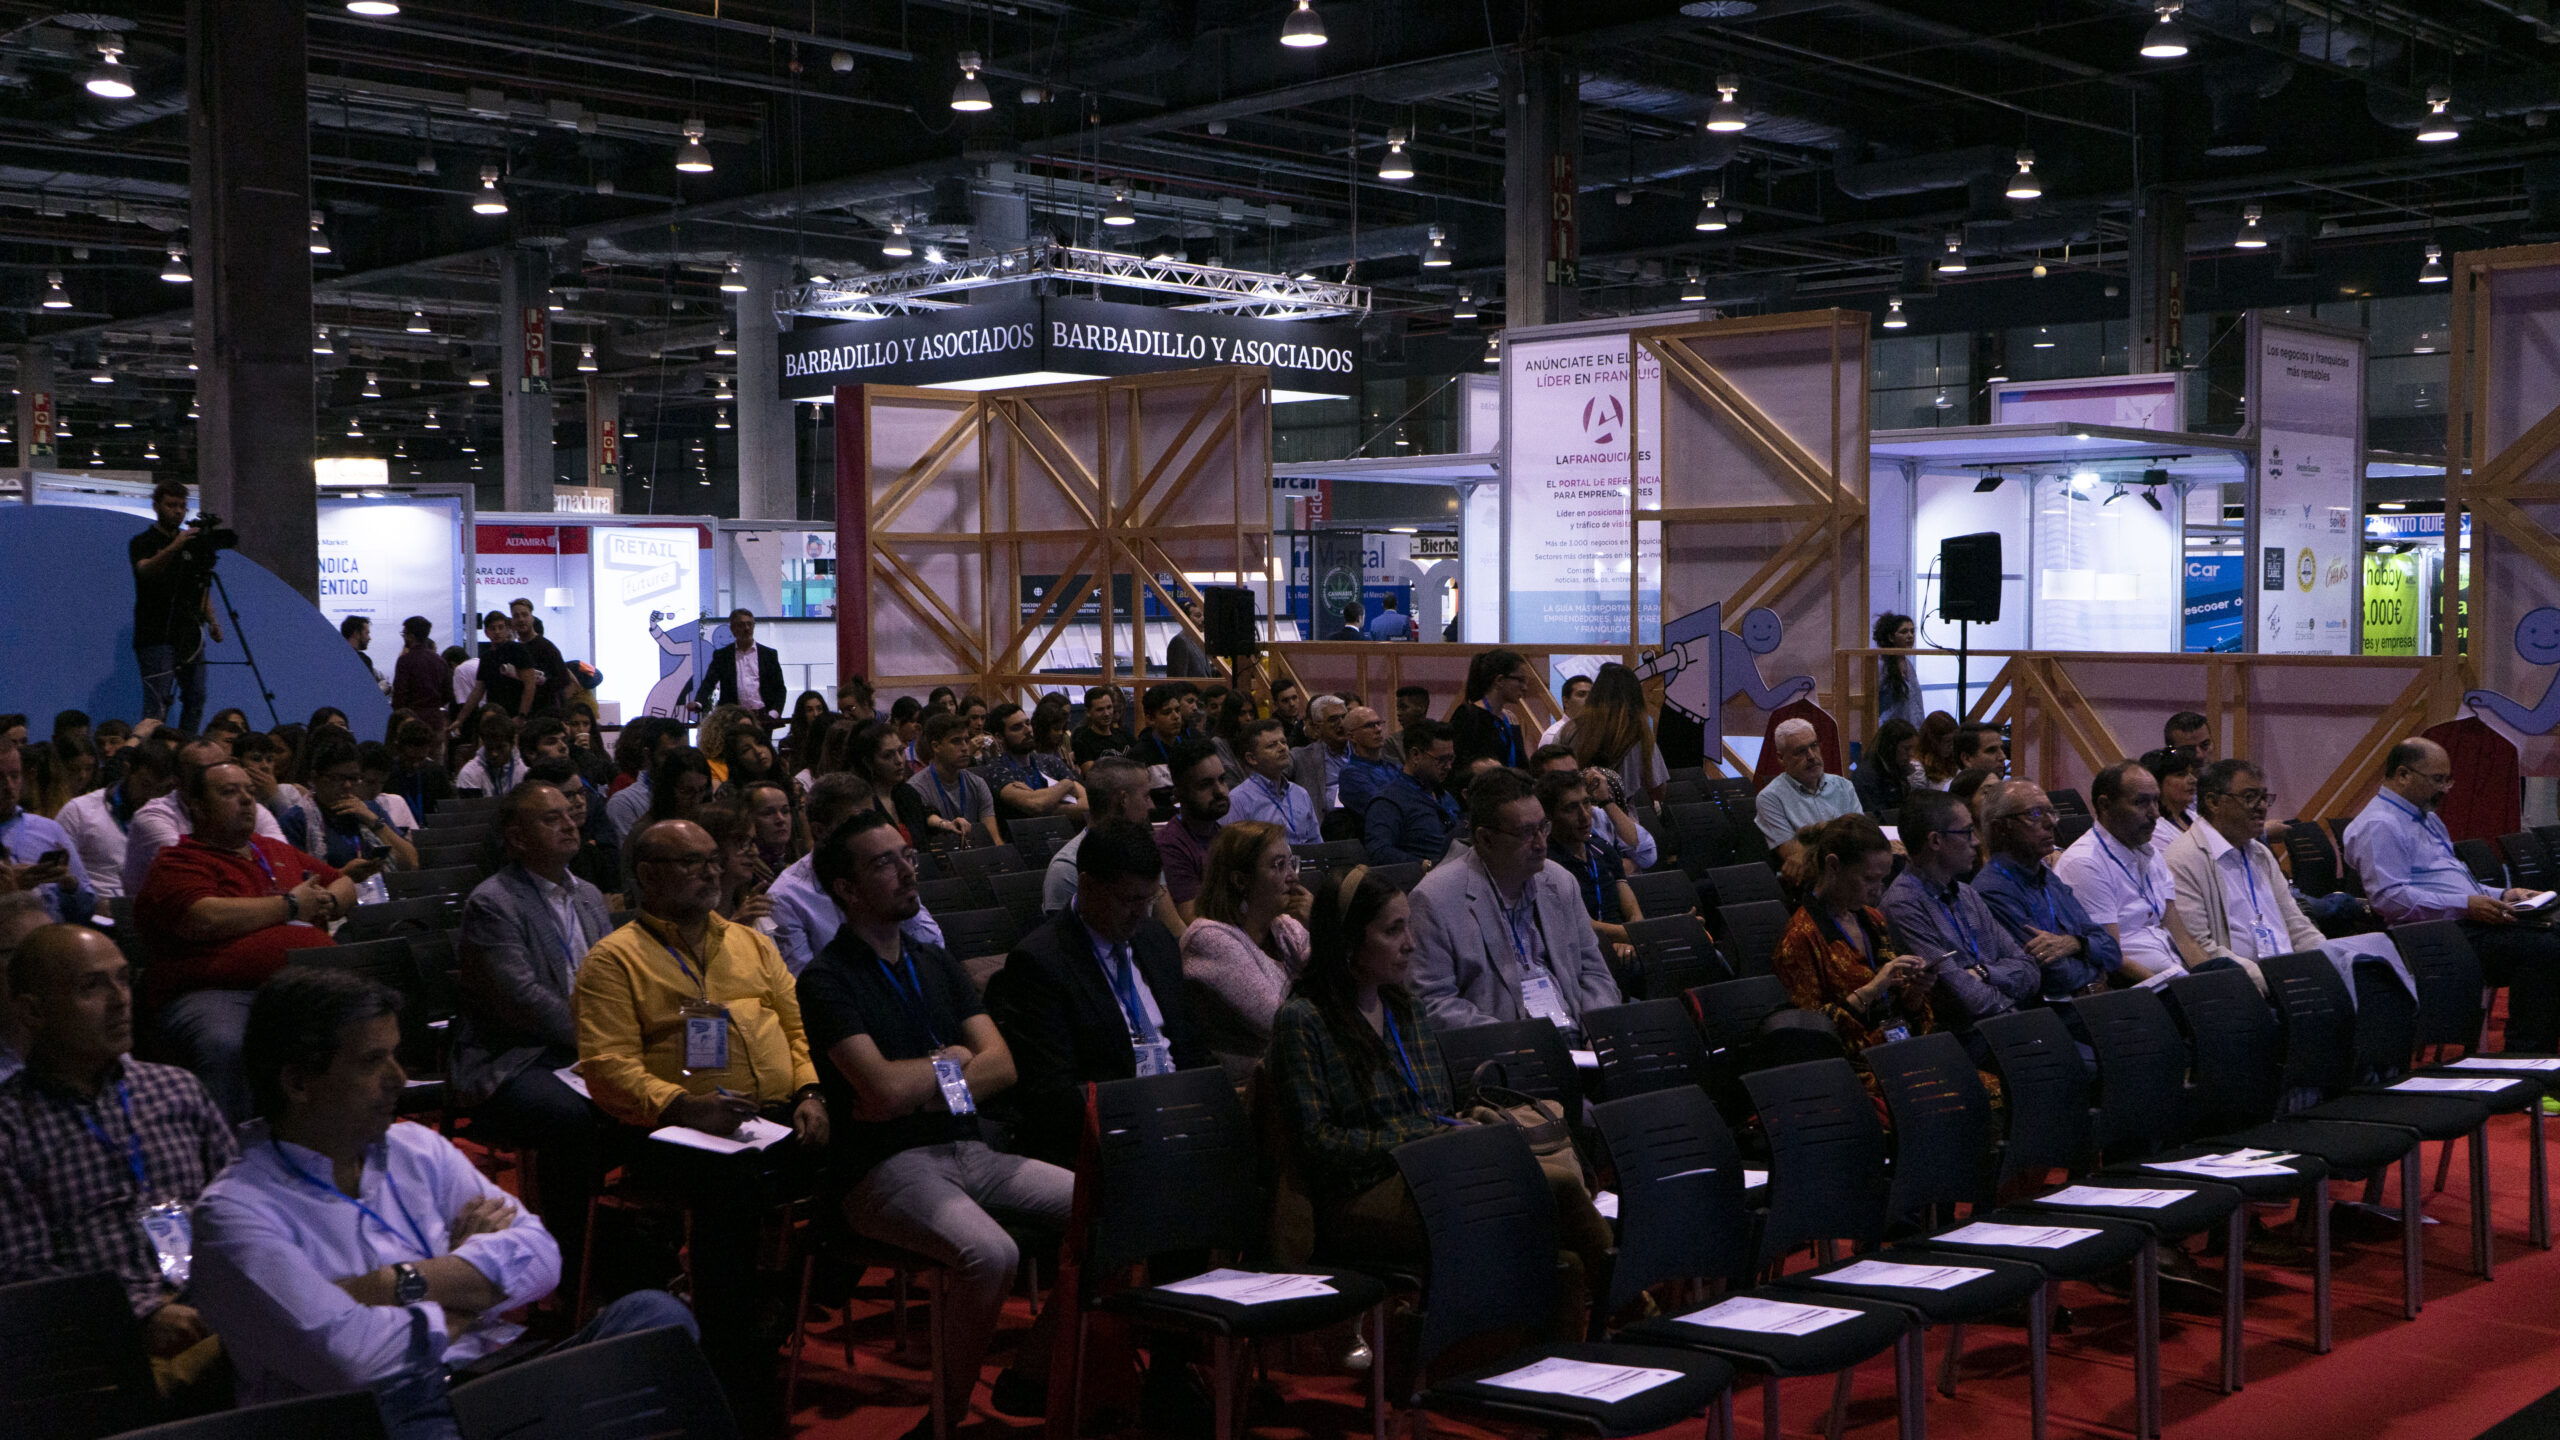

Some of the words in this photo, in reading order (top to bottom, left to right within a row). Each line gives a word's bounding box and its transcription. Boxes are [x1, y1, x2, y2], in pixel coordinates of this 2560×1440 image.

[785, 341, 898, 377] BARBADILLO
[903, 338, 916, 362] Y
[919, 323, 1034, 360] ASOCIADOS
[1052, 321, 1205, 360] BARBADILLO
[1211, 337, 1226, 361] Y
[1231, 338, 1353, 373] ASOCIADOS
[1525, 356, 1593, 371] ANÚNCIATE
[1597, 354, 1613, 366] EN
[1617, 352, 1631, 364] EL
[1537, 374, 1571, 388] LÍDER
[1575, 373, 1591, 385] EN
[1594, 367, 1660, 383] FRANUIC
[1559, 479, 1591, 488] PORTAL
[505, 538, 547, 547] ALTAMIRA
[615, 538, 677, 558] RETAIL
[485, 577, 529, 585] REALIDAD
[496, 568, 515, 576] QUE
